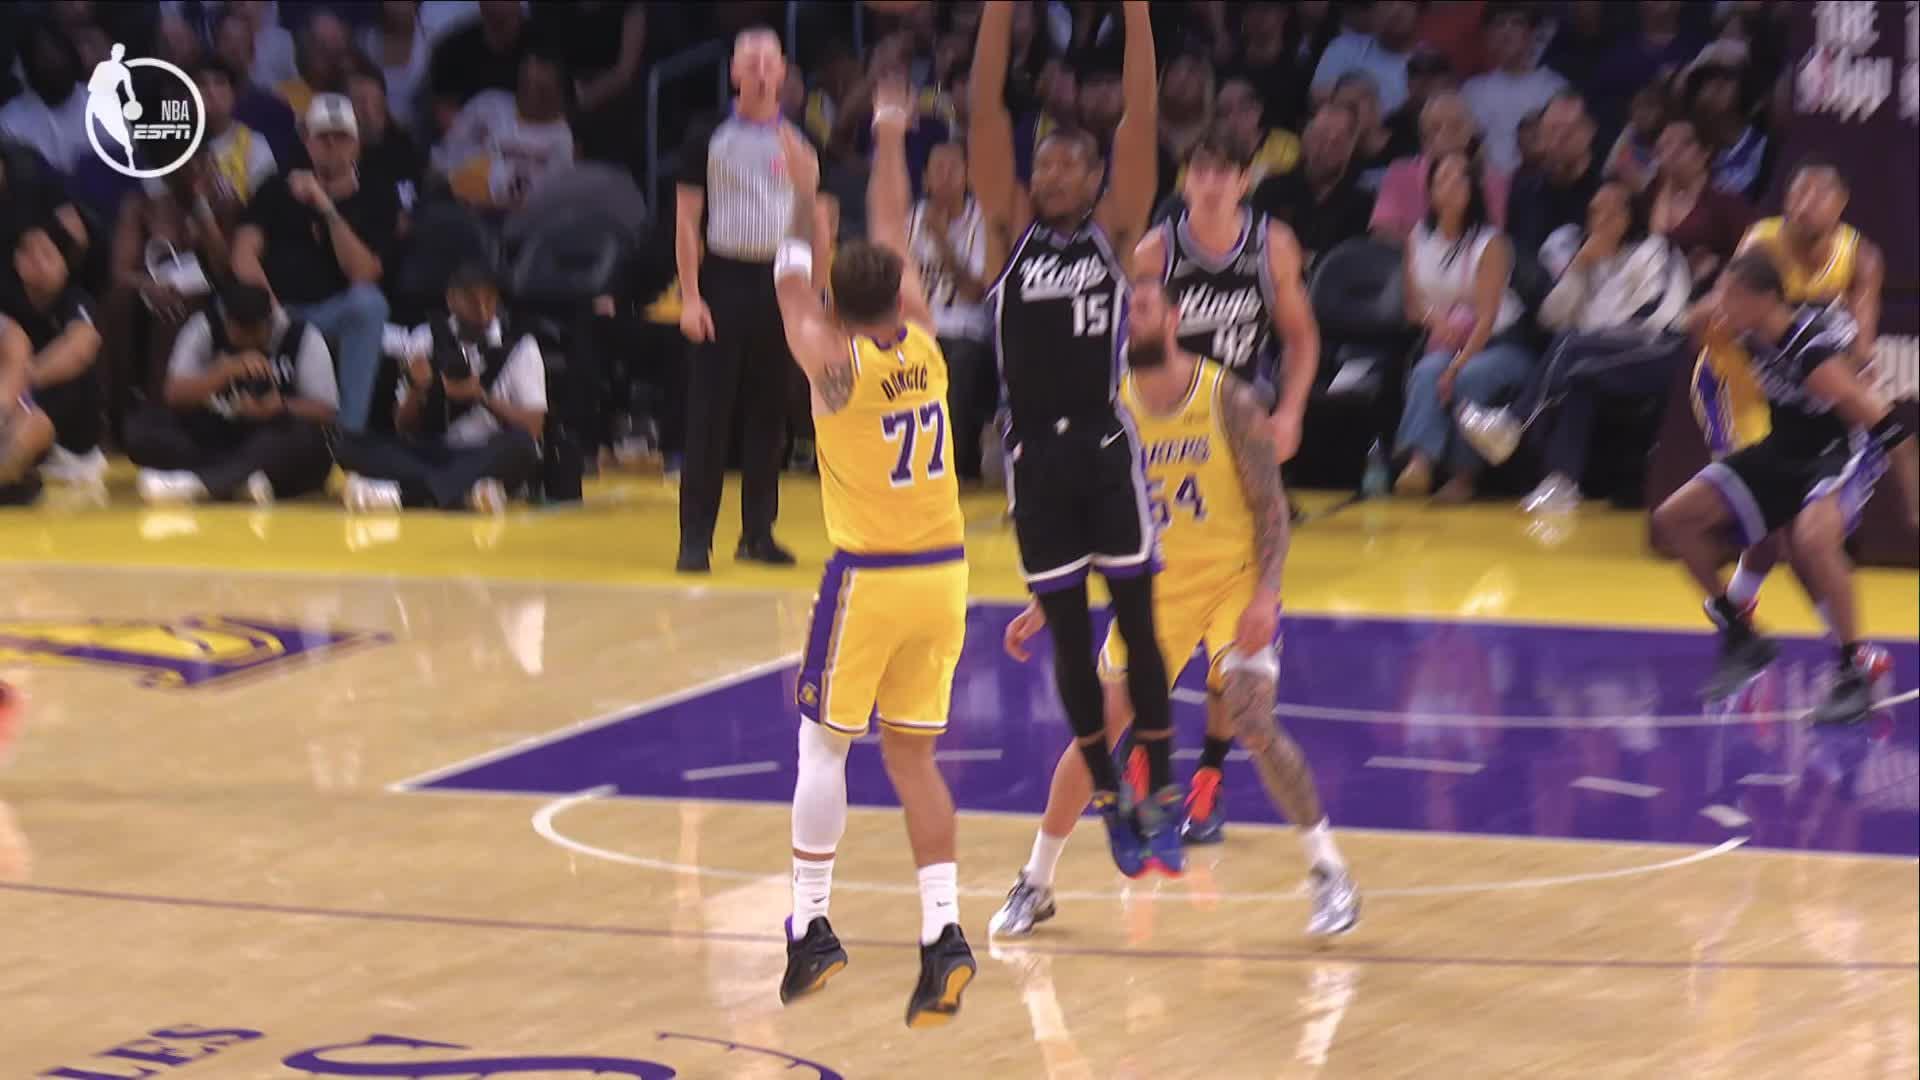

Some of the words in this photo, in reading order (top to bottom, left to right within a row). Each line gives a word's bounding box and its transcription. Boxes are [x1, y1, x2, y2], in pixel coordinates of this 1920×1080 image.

[1019, 253, 1108, 302] Kings
[1072, 292, 1110, 337] 15
[881, 400, 945, 488] 77
